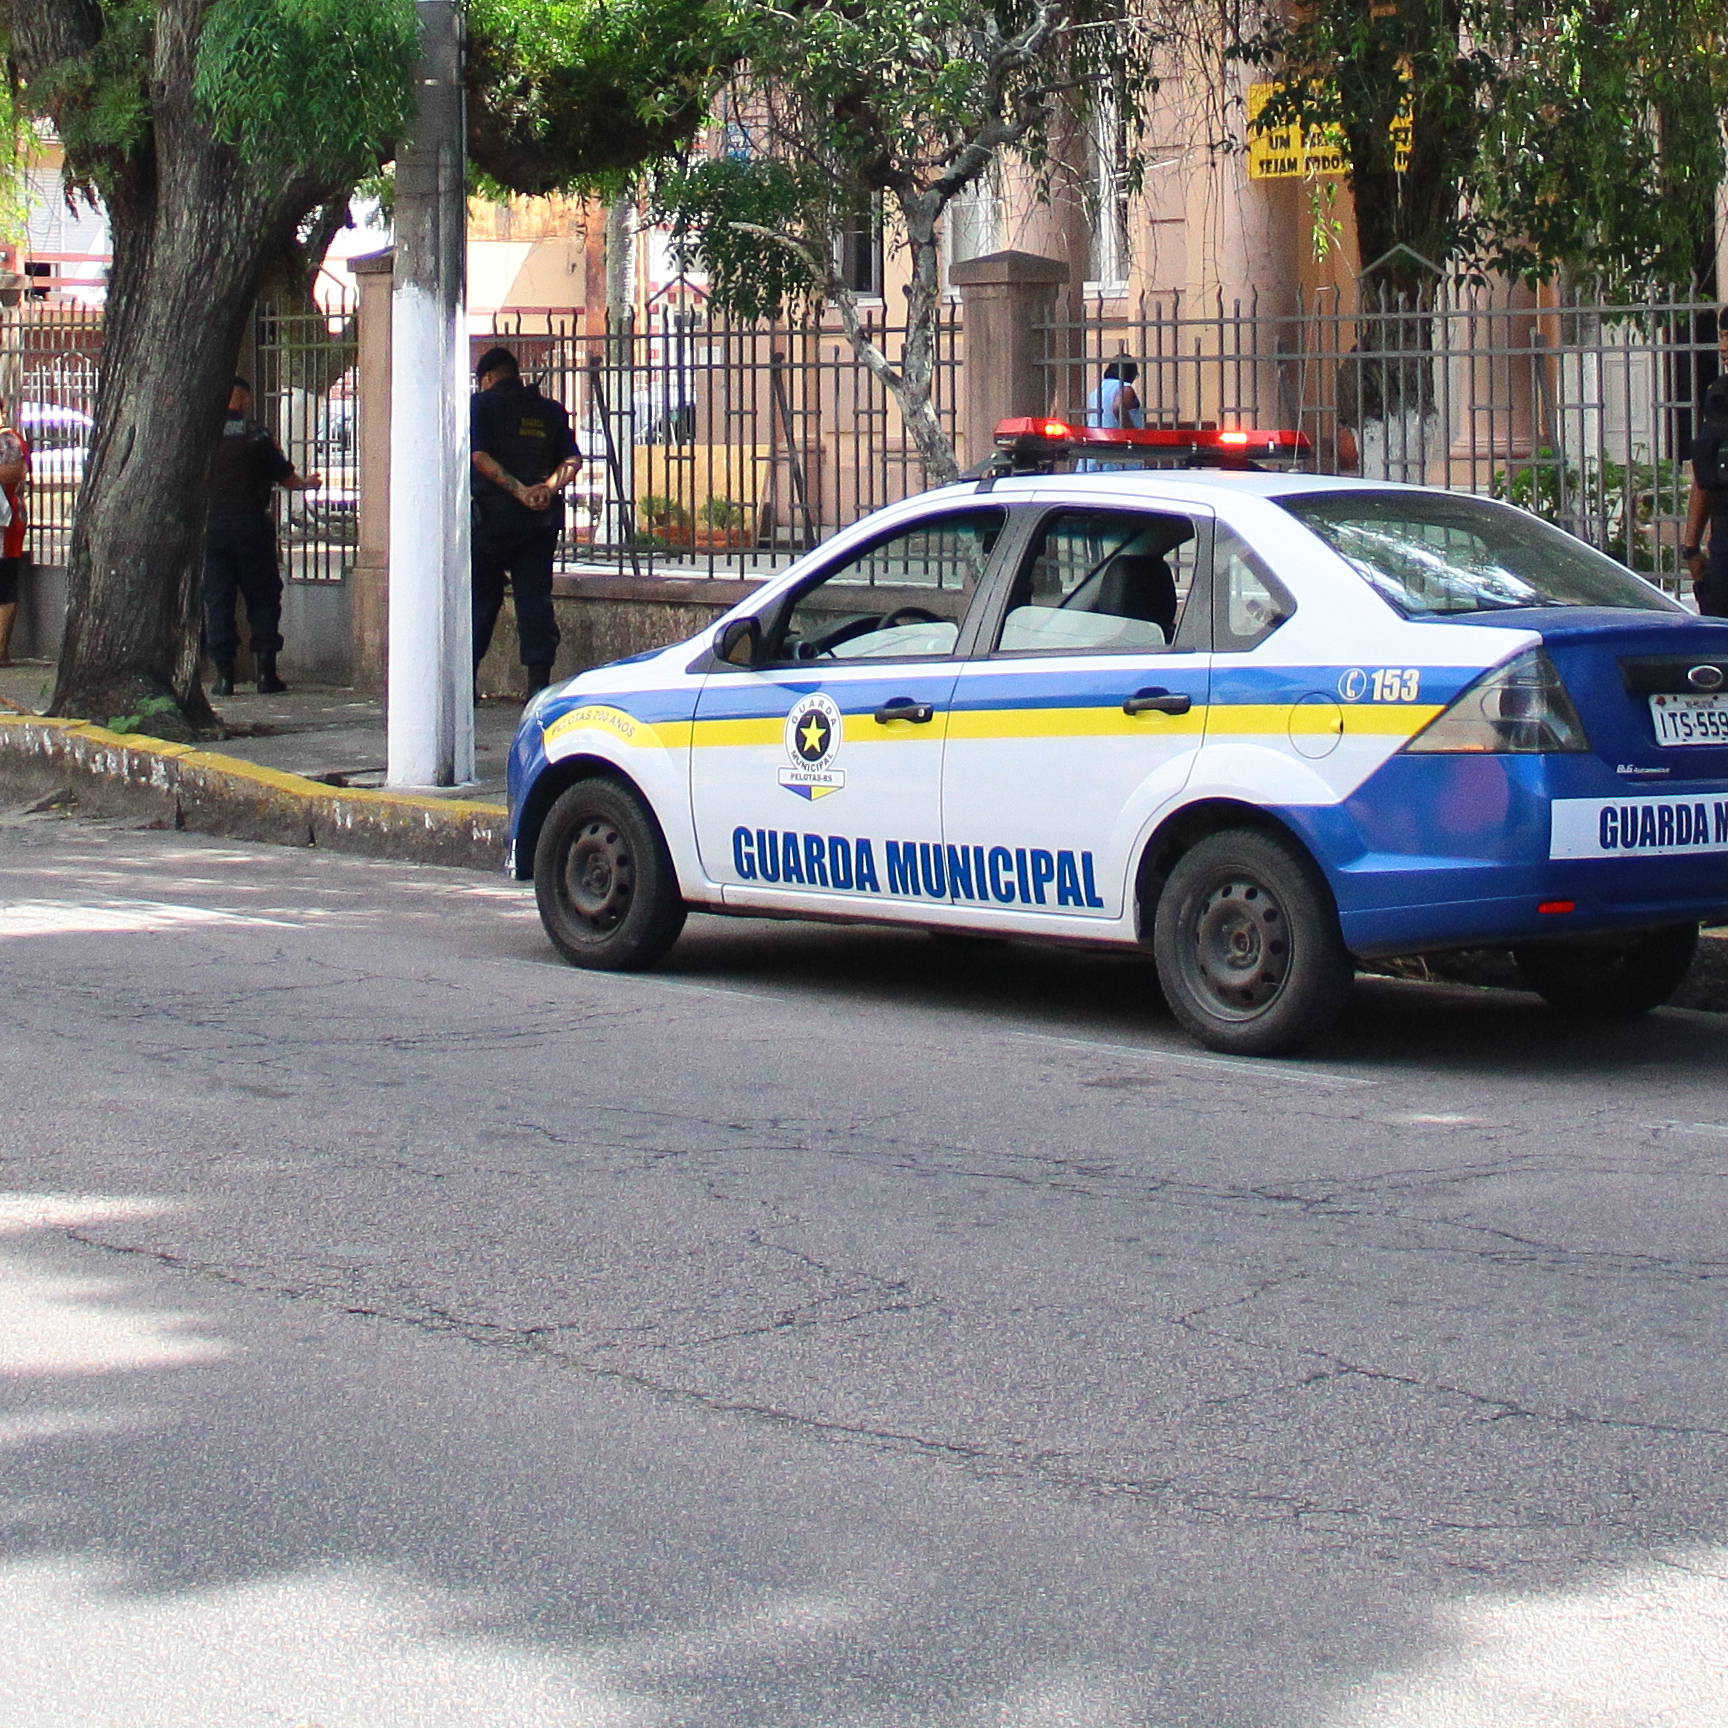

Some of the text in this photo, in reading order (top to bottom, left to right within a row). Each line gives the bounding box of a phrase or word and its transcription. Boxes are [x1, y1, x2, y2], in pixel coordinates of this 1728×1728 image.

[1371, 668, 1420, 702] 153
[609, 715, 636, 738] ANOS
[791, 699, 837, 726] GUARDA
[791, 749, 834, 773] MUNICIPAL
[1598, 802, 1710, 850] GUARDA
[732, 825, 1105, 908] GUARDA MUNICIPAL
